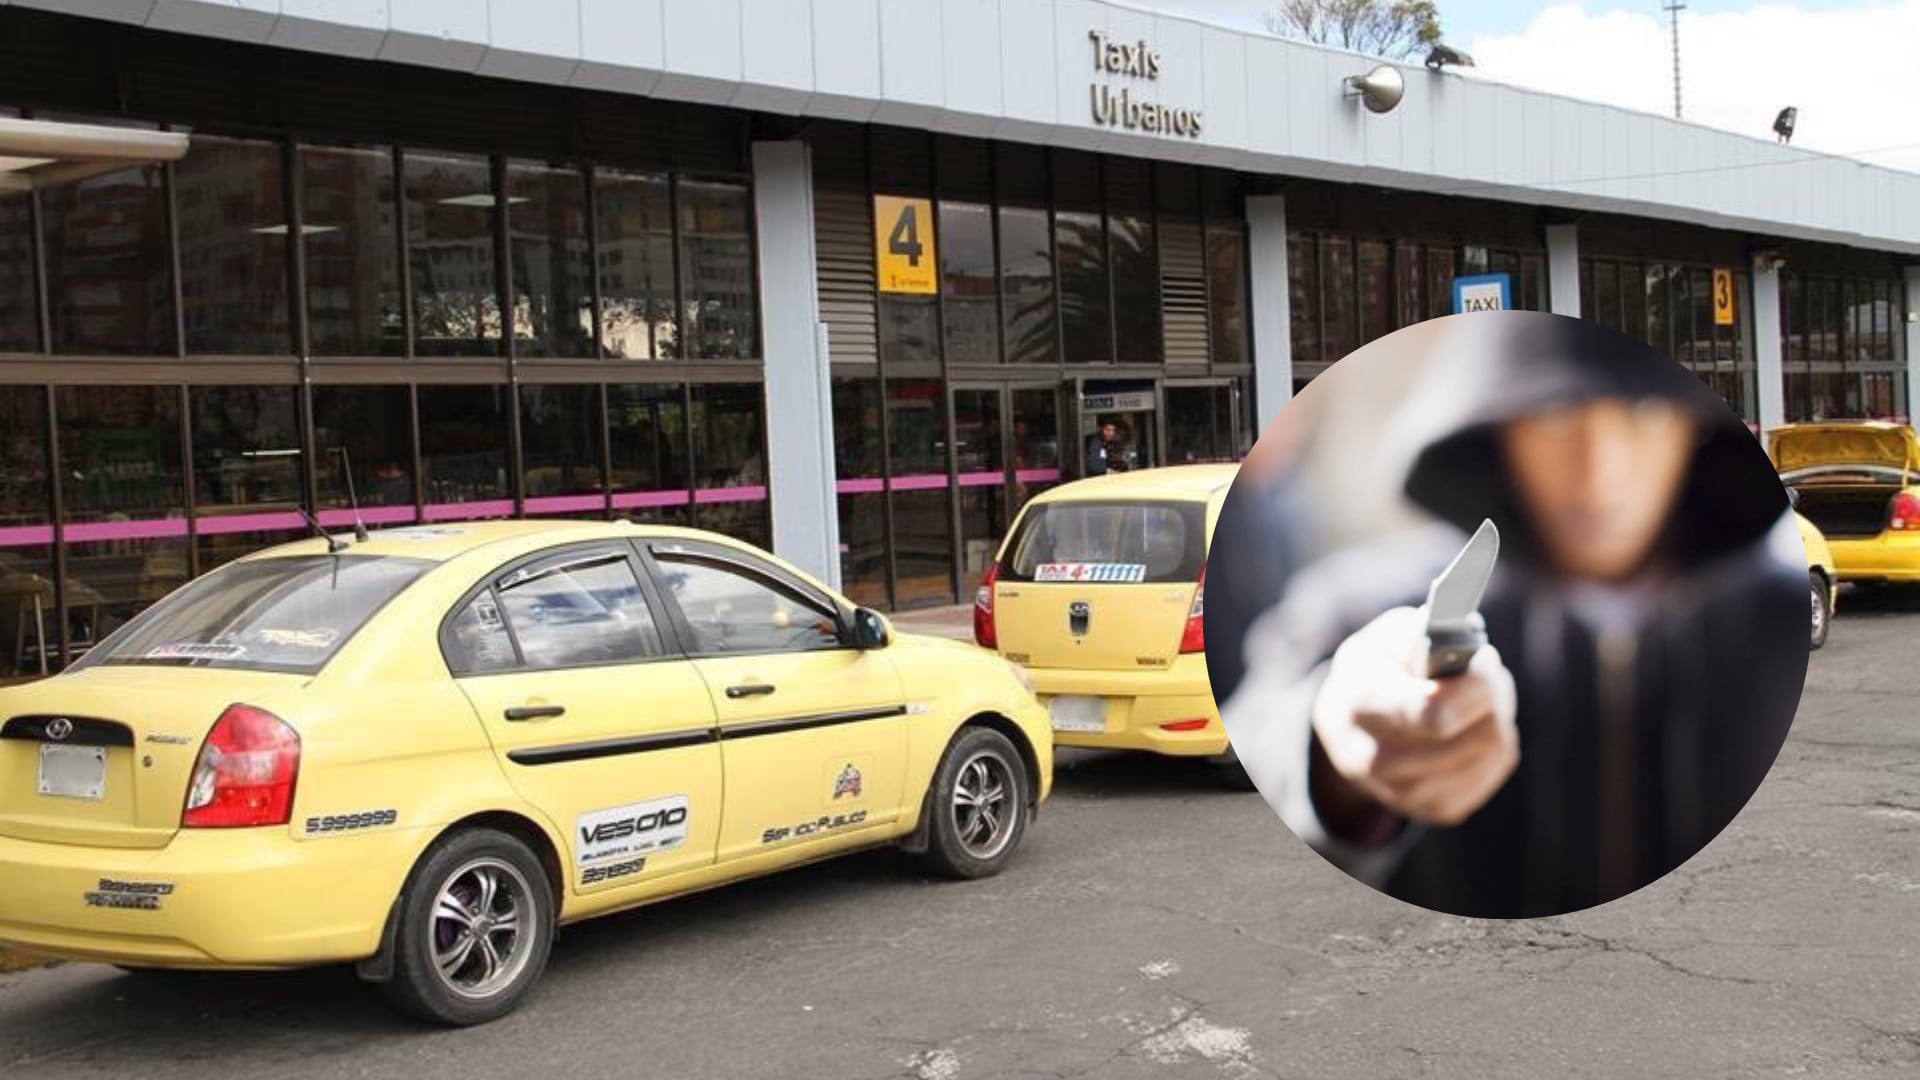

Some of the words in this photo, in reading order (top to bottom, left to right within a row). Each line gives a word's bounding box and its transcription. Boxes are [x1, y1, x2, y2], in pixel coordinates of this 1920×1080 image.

[1088, 29, 1160, 80] Taxis
[1090, 83, 1203, 138] Urbanos
[889, 204, 922, 267] 4
[1464, 296, 1500, 312] TAXI
[1717, 274, 1728, 309] 3
